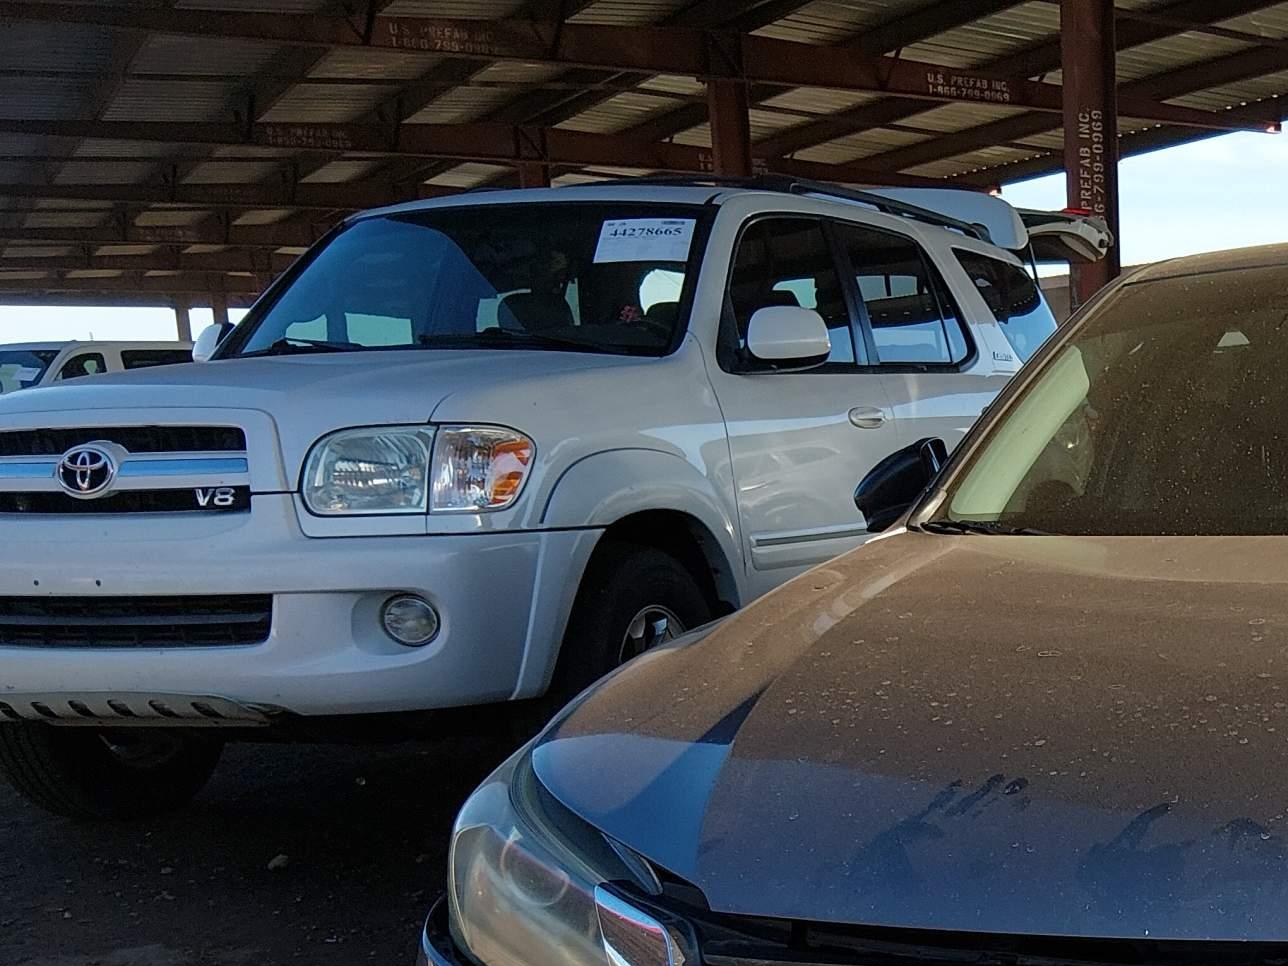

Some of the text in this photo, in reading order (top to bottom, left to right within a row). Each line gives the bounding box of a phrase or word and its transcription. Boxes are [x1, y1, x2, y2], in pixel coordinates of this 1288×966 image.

[951, 75, 988, 90] PREFAB
[1090, 110, 1105, 221] 6-799-0969
[1079, 147, 1092, 210] PREFAB
[609, 227, 683, 238] 44278665
[194, 487, 237, 507] V8
